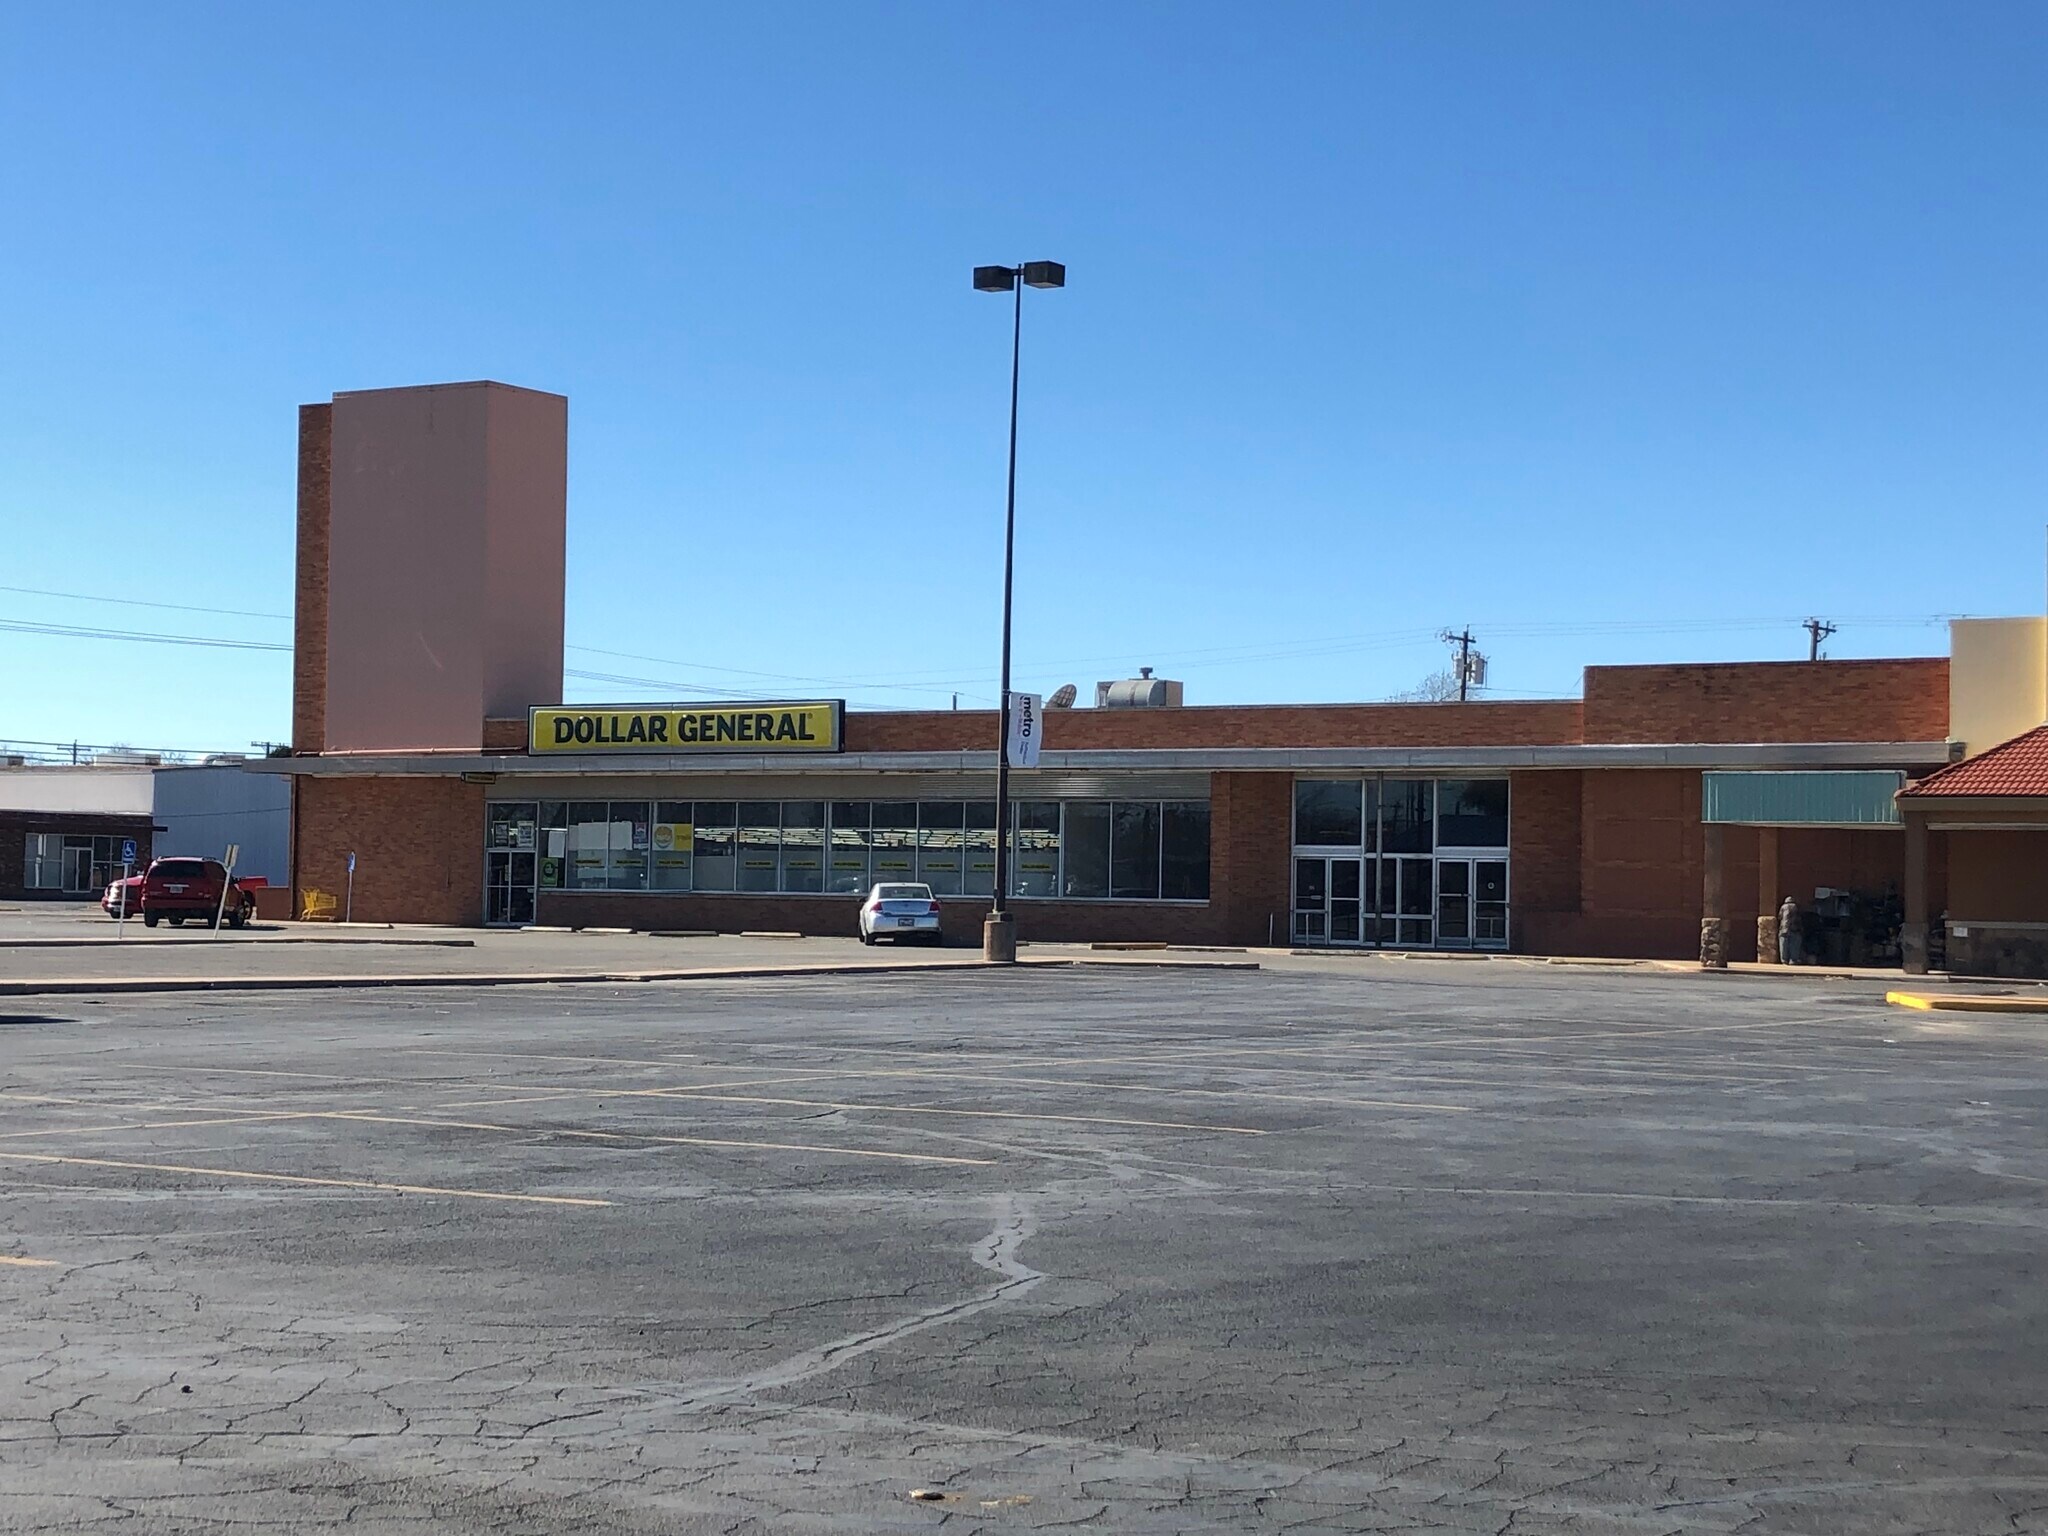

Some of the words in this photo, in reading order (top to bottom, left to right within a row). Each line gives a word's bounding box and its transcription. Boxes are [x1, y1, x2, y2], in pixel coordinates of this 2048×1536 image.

[553, 715, 668, 743] DOLLAR
[678, 713, 815, 742] GENERAL
[1022, 696, 1034, 737] metro
